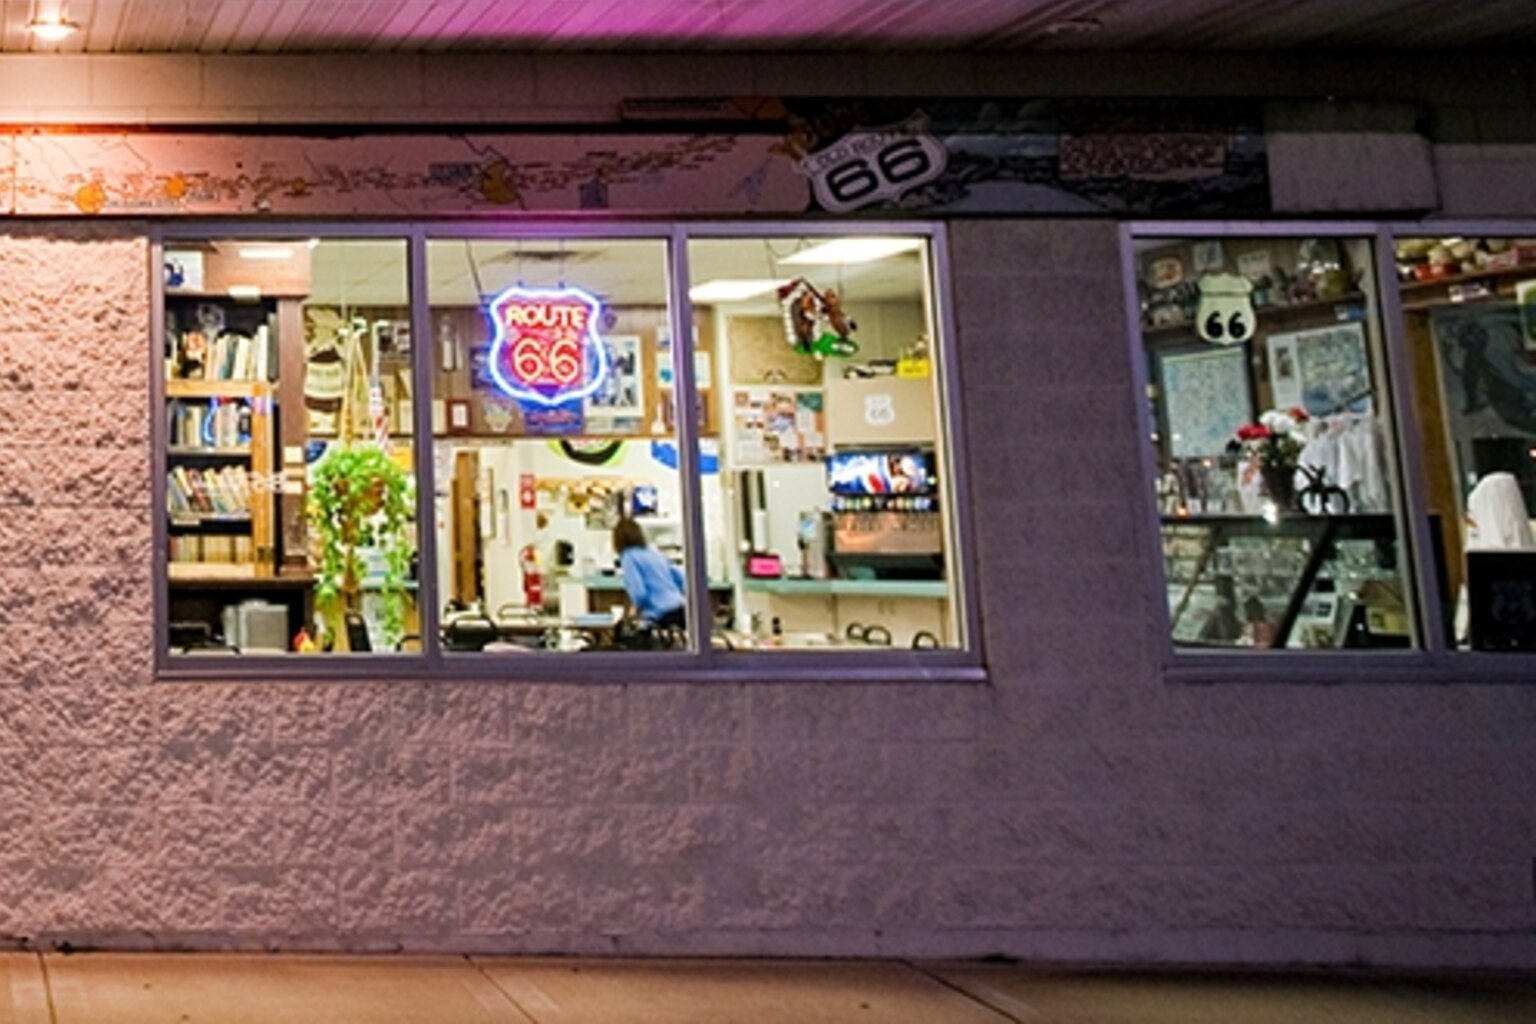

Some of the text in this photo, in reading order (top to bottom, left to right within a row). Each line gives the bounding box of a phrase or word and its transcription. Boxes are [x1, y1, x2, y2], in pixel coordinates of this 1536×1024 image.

[826, 139, 930, 202] 66
[506, 305, 585, 327] ROUTE
[1205, 310, 1246, 339] 66
[514, 338, 579, 383] 66
